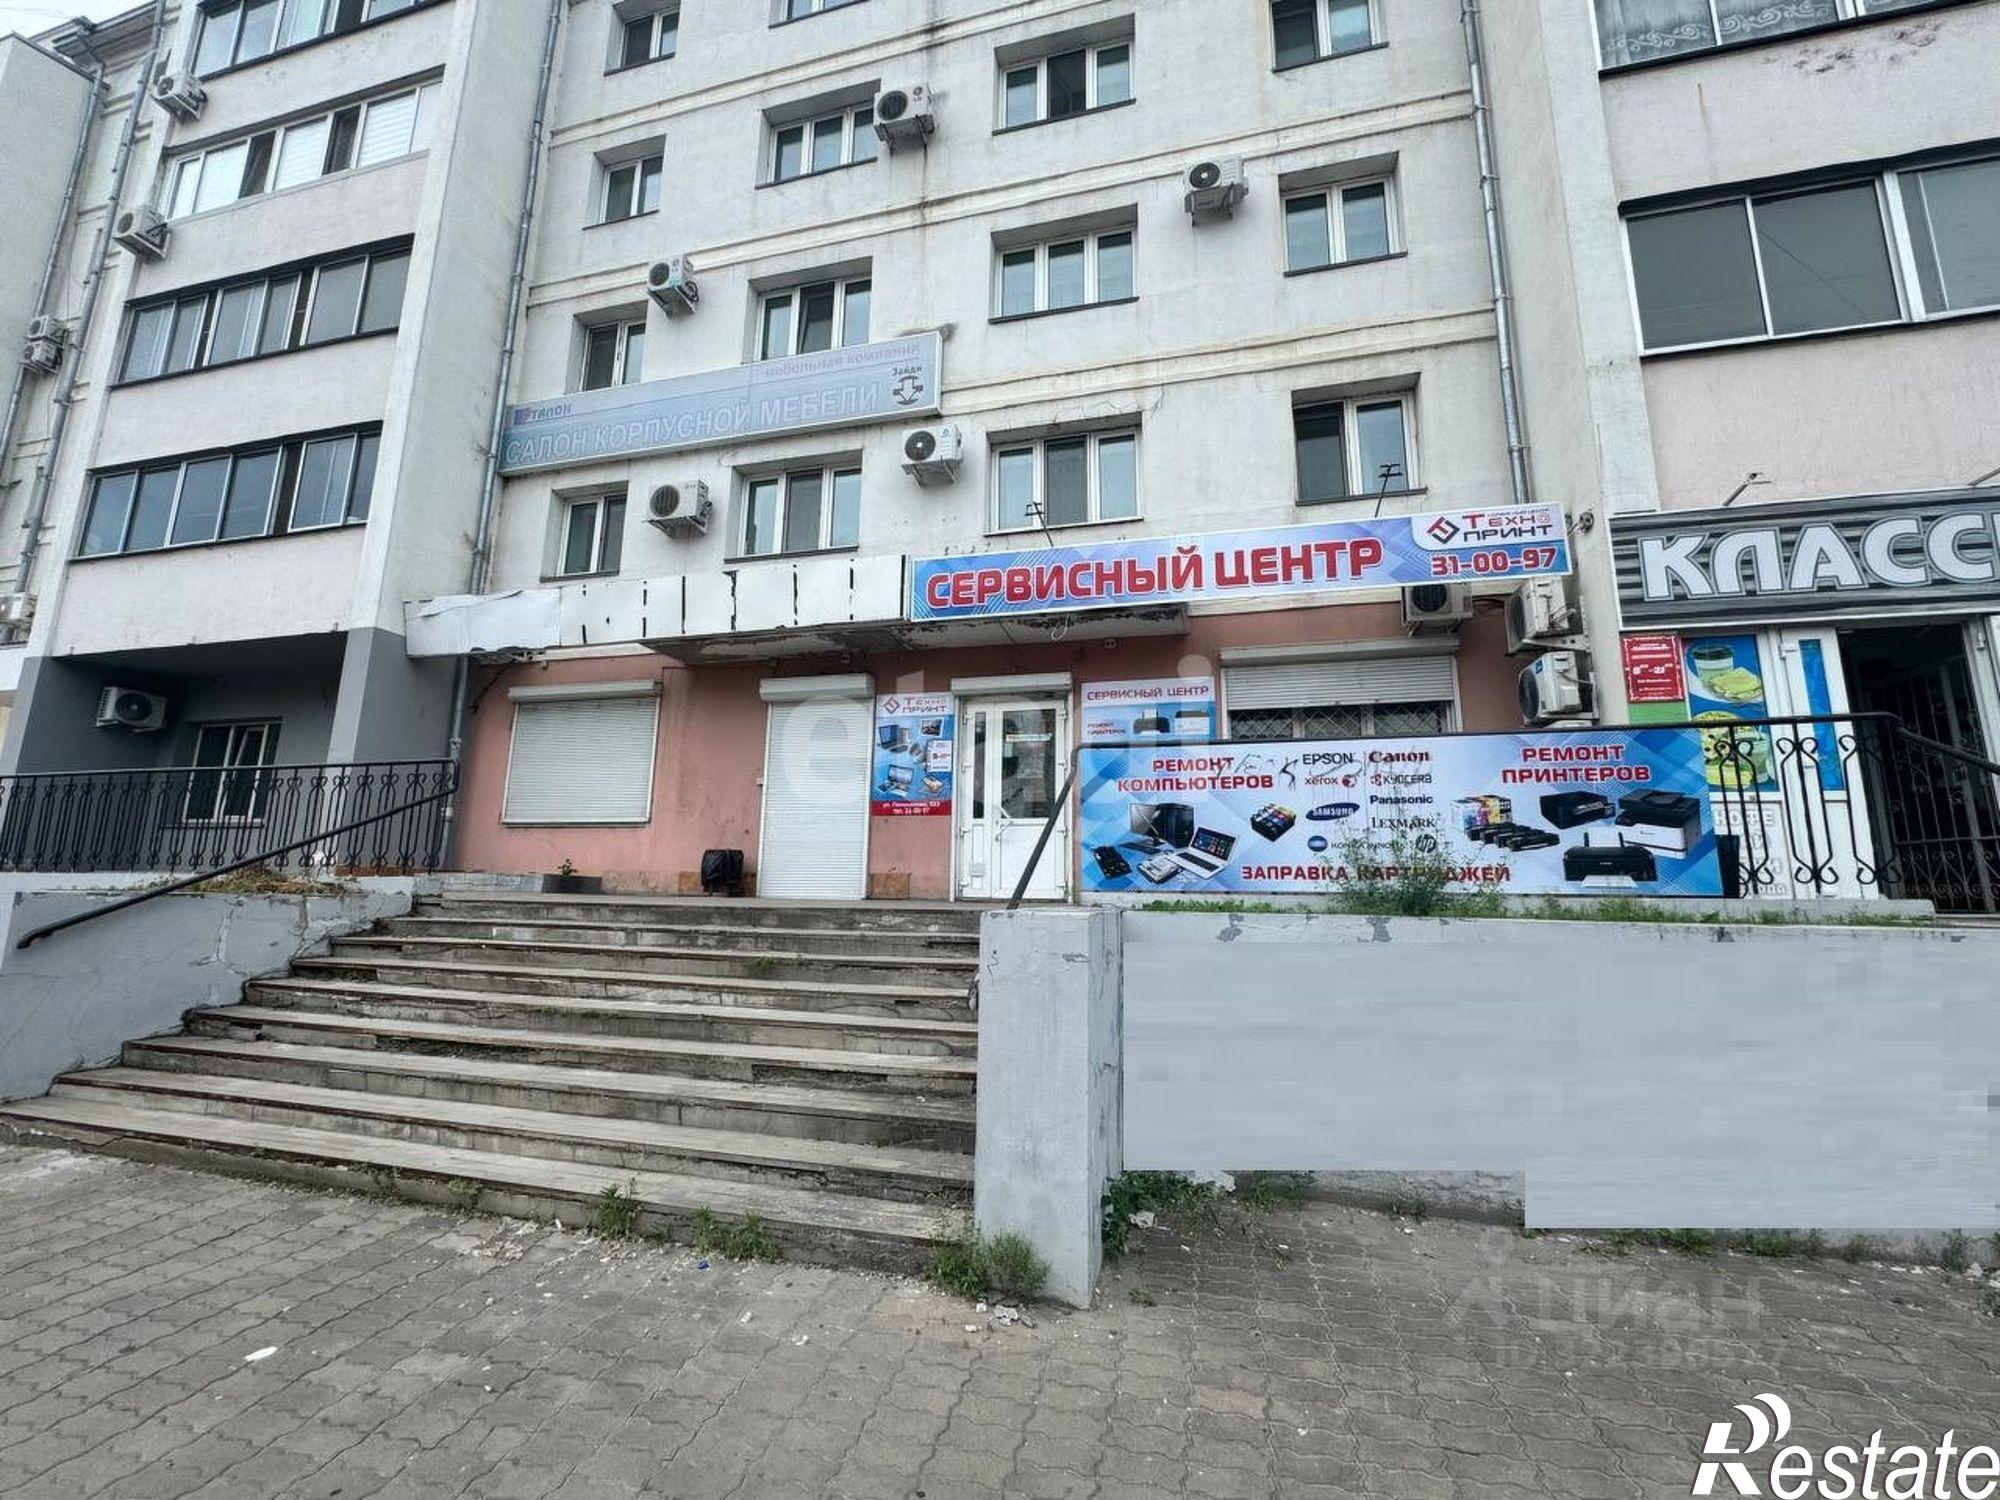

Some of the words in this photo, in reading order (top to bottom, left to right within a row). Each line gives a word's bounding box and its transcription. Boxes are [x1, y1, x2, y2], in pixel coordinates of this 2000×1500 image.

[505, 429, 588, 464] САЛОН
[594, 399, 752, 451] КОРПУСНОЙ
[756, 380, 882, 426] МЕБЕЛИ
[1463, 524, 1553, 542] ПРИНТ
[1431, 547, 1557, 577] 31-00-97
[1638, 510, 2000, 601] КЛАСС
[927, 545, 1202, 609] СЕРВИСНЫЙ
[1215, 536, 1384, 588] ЦЕНТР
[1086, 687, 1163, 701] СЕРВИСНЫЙ
[1166, 685, 1210, 698] ЦЕНТР
[1302, 752, 1355, 765] EPSON
[1368, 750, 1431, 763] Canon
[1521, 744, 1625, 763] РЕМОНТ
[1153, 757, 1235, 773] РЕМОНТ
[1117, 774, 1274, 792] КОМПЬЮТЕРОВ
[1304, 776, 1339, 786] xerox
[1501, 766, 1651, 784] ПРИНТЕРОВ
[1369, 794, 1434, 805] Panasonic
[1312, 805, 1355, 817] SAMSUNG
[1241, 865, 1349, 881] ЗАПРАВКА
[1356, 862, 1512, 882] КАРТДЖЕЙ
